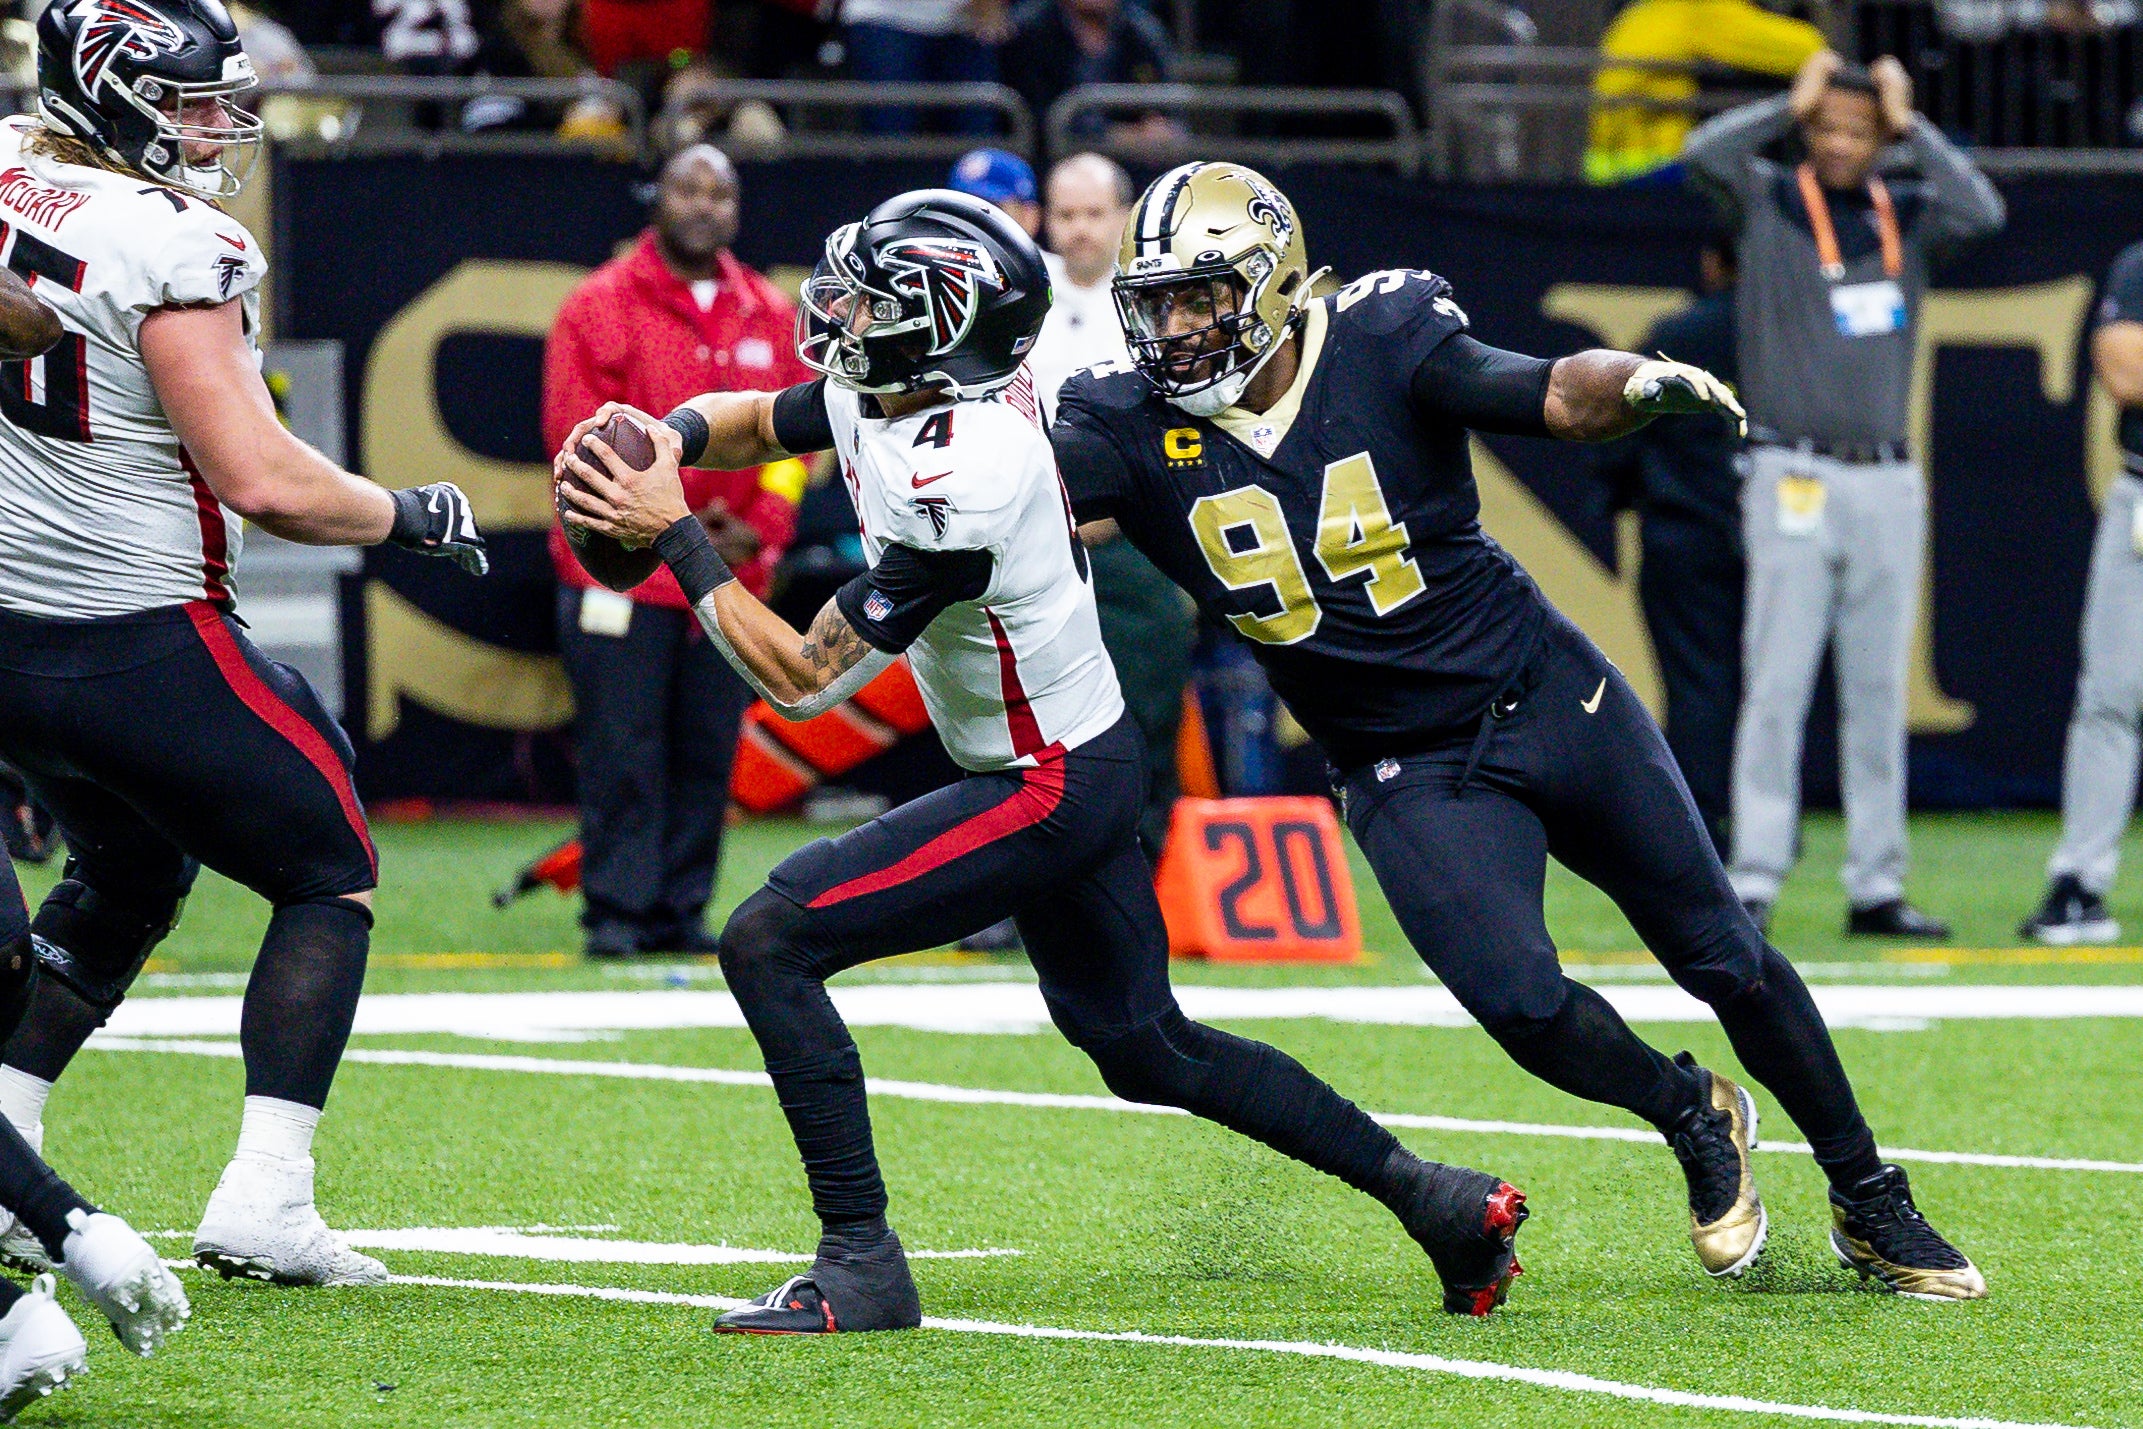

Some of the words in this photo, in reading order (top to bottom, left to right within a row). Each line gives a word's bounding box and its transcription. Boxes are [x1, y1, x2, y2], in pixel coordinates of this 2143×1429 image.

[912, 409, 954, 449] 4
[1165, 427, 1202, 459] C
[1188, 450, 1427, 645] 94
[1204, 822, 1343, 940] 20
